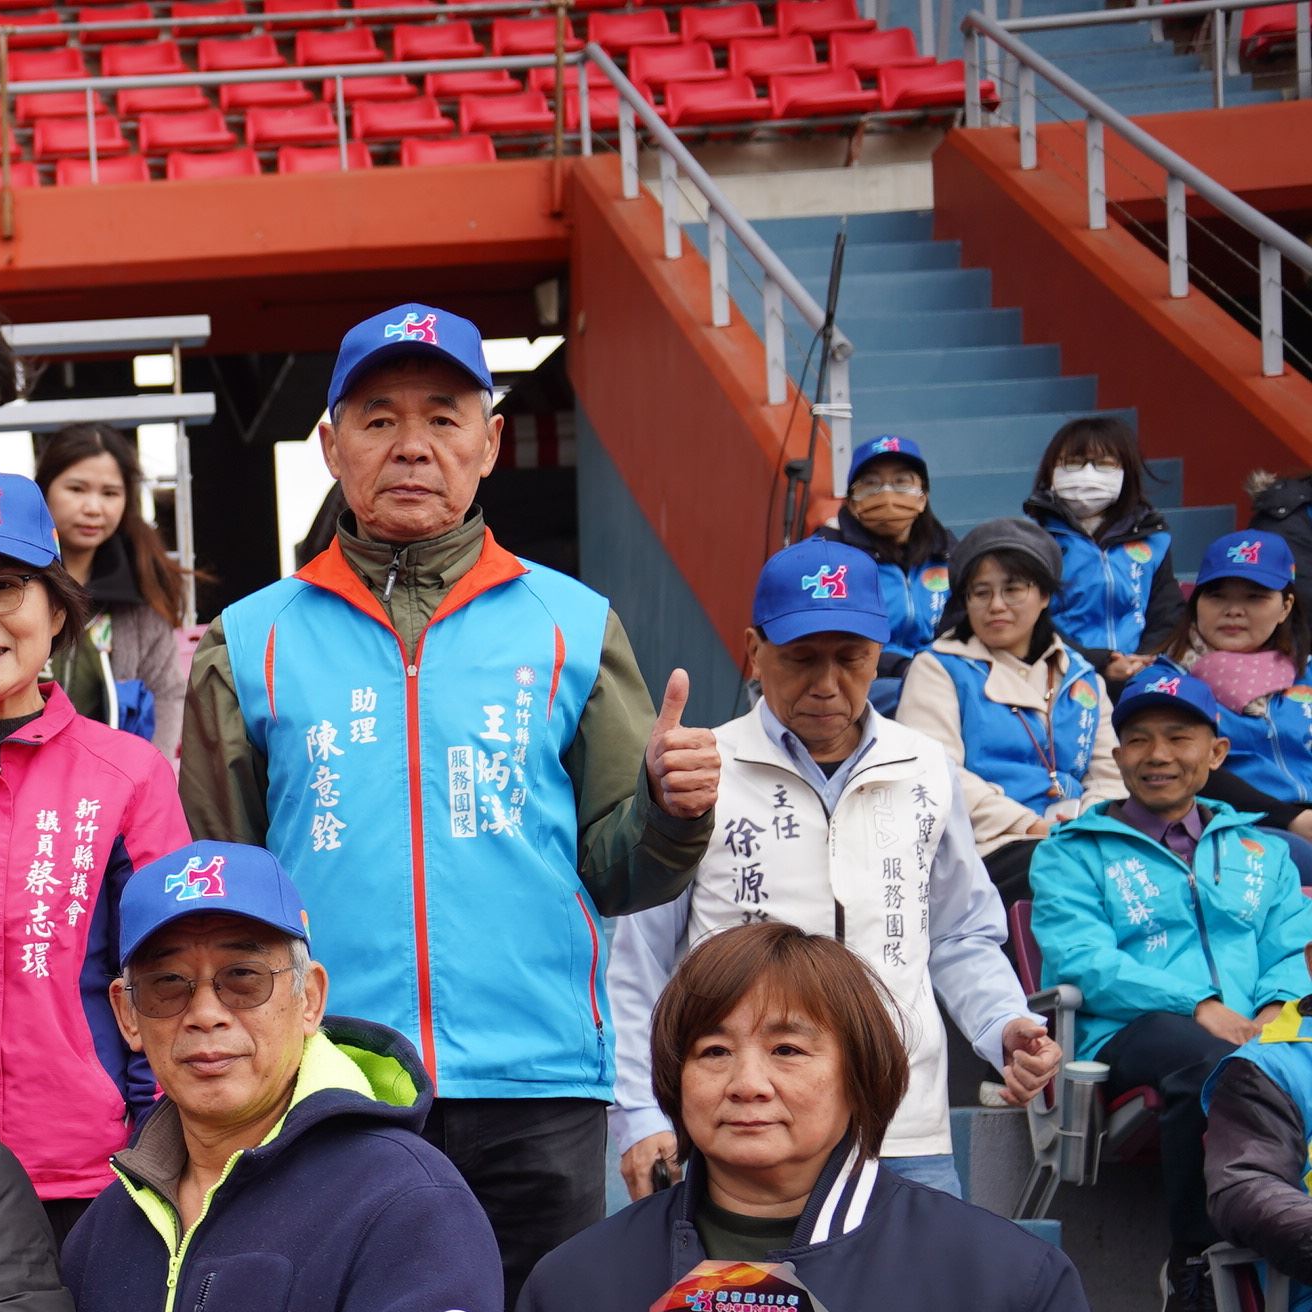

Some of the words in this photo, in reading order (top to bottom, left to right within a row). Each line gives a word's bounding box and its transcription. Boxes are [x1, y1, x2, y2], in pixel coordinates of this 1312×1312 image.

[349, 686, 378, 744] 助理
[306, 719, 347, 852] 陳意銓
[450, 749, 475, 837] 服務團隊
[771, 784, 801, 840] 主任
[64, 798, 101, 927] 新竹縣議會
[724, 816, 770, 925] 徐源
[882, 857, 907, 968] 服務團隊
